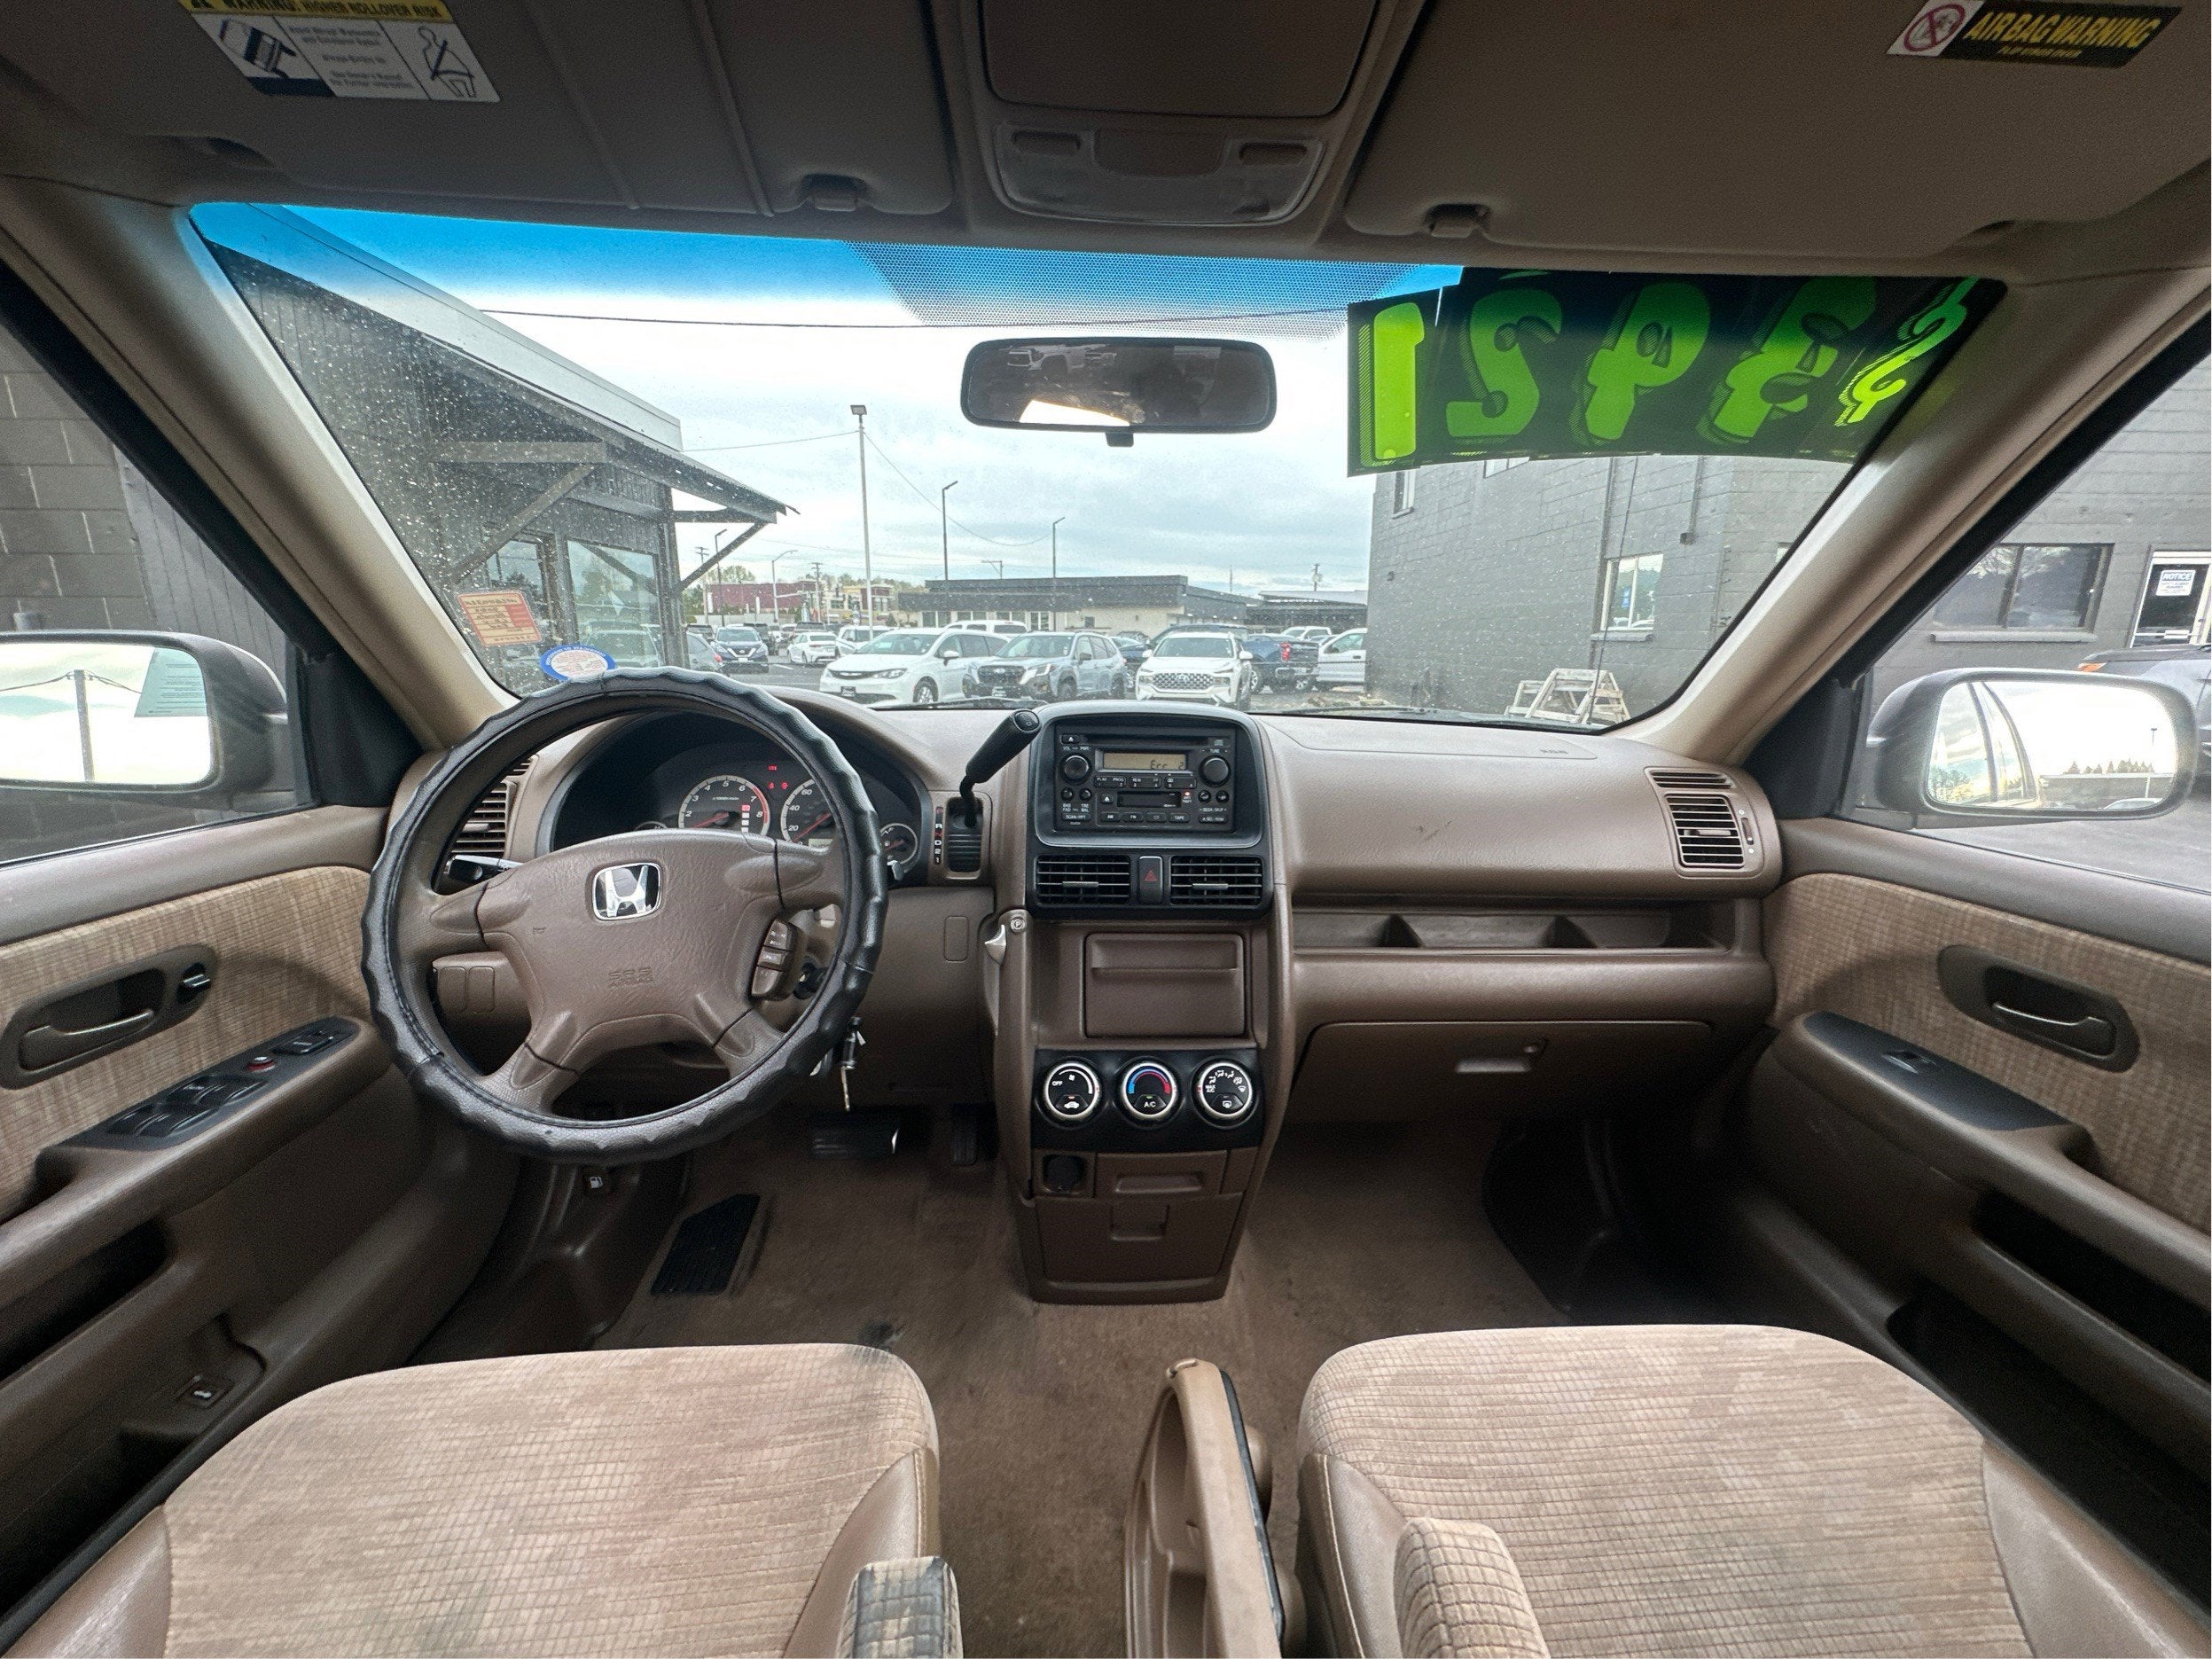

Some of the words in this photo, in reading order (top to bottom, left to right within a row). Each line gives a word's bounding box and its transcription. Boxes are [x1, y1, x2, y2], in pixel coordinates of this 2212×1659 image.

[1962, 12, 2061, 45] AIRBAG
[2046, 15, 2163, 49] WARNING
[2163, 572, 2192, 581] NOTICE
[1150, 760, 1168, 770] Err
